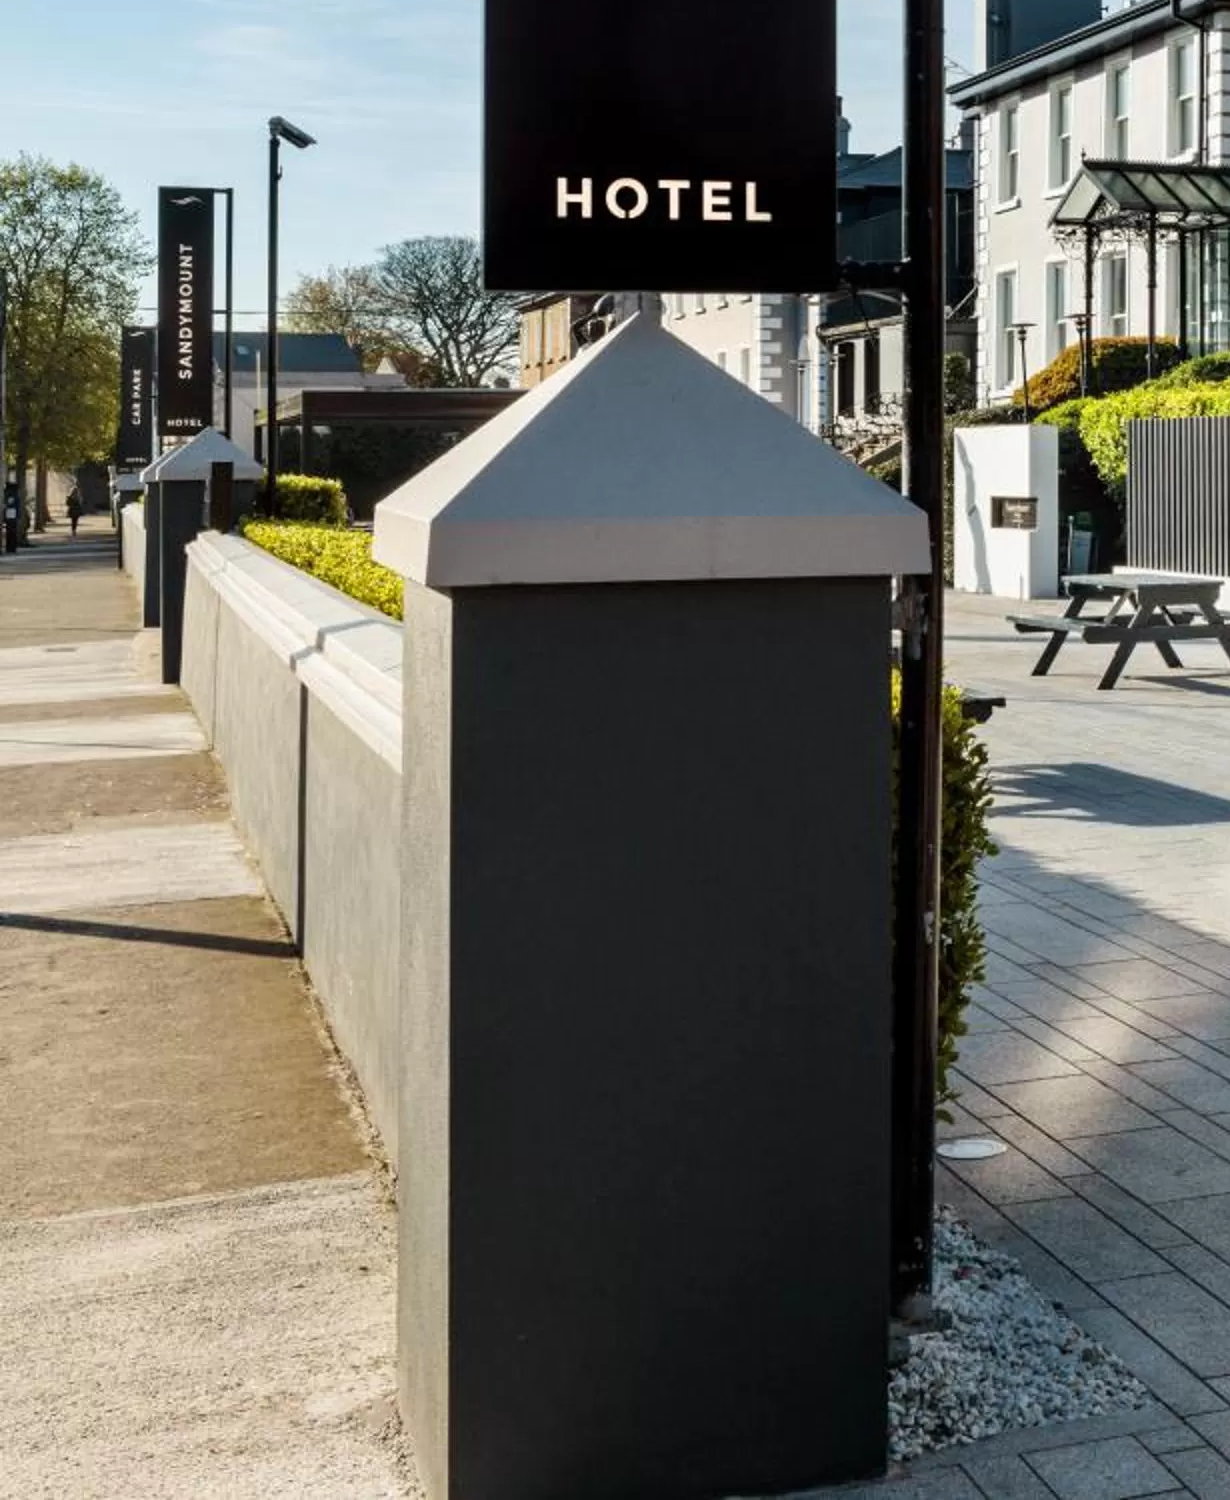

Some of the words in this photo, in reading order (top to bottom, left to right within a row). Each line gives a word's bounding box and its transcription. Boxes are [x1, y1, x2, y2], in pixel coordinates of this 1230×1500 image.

[556, 177, 773, 222] HOTEL
[178, 243, 193, 379] SANDYMOUNT
[132, 369, 141, 398] PARK
[132, 402, 141, 425] CAR
[166, 418, 203, 428] HOTEL
